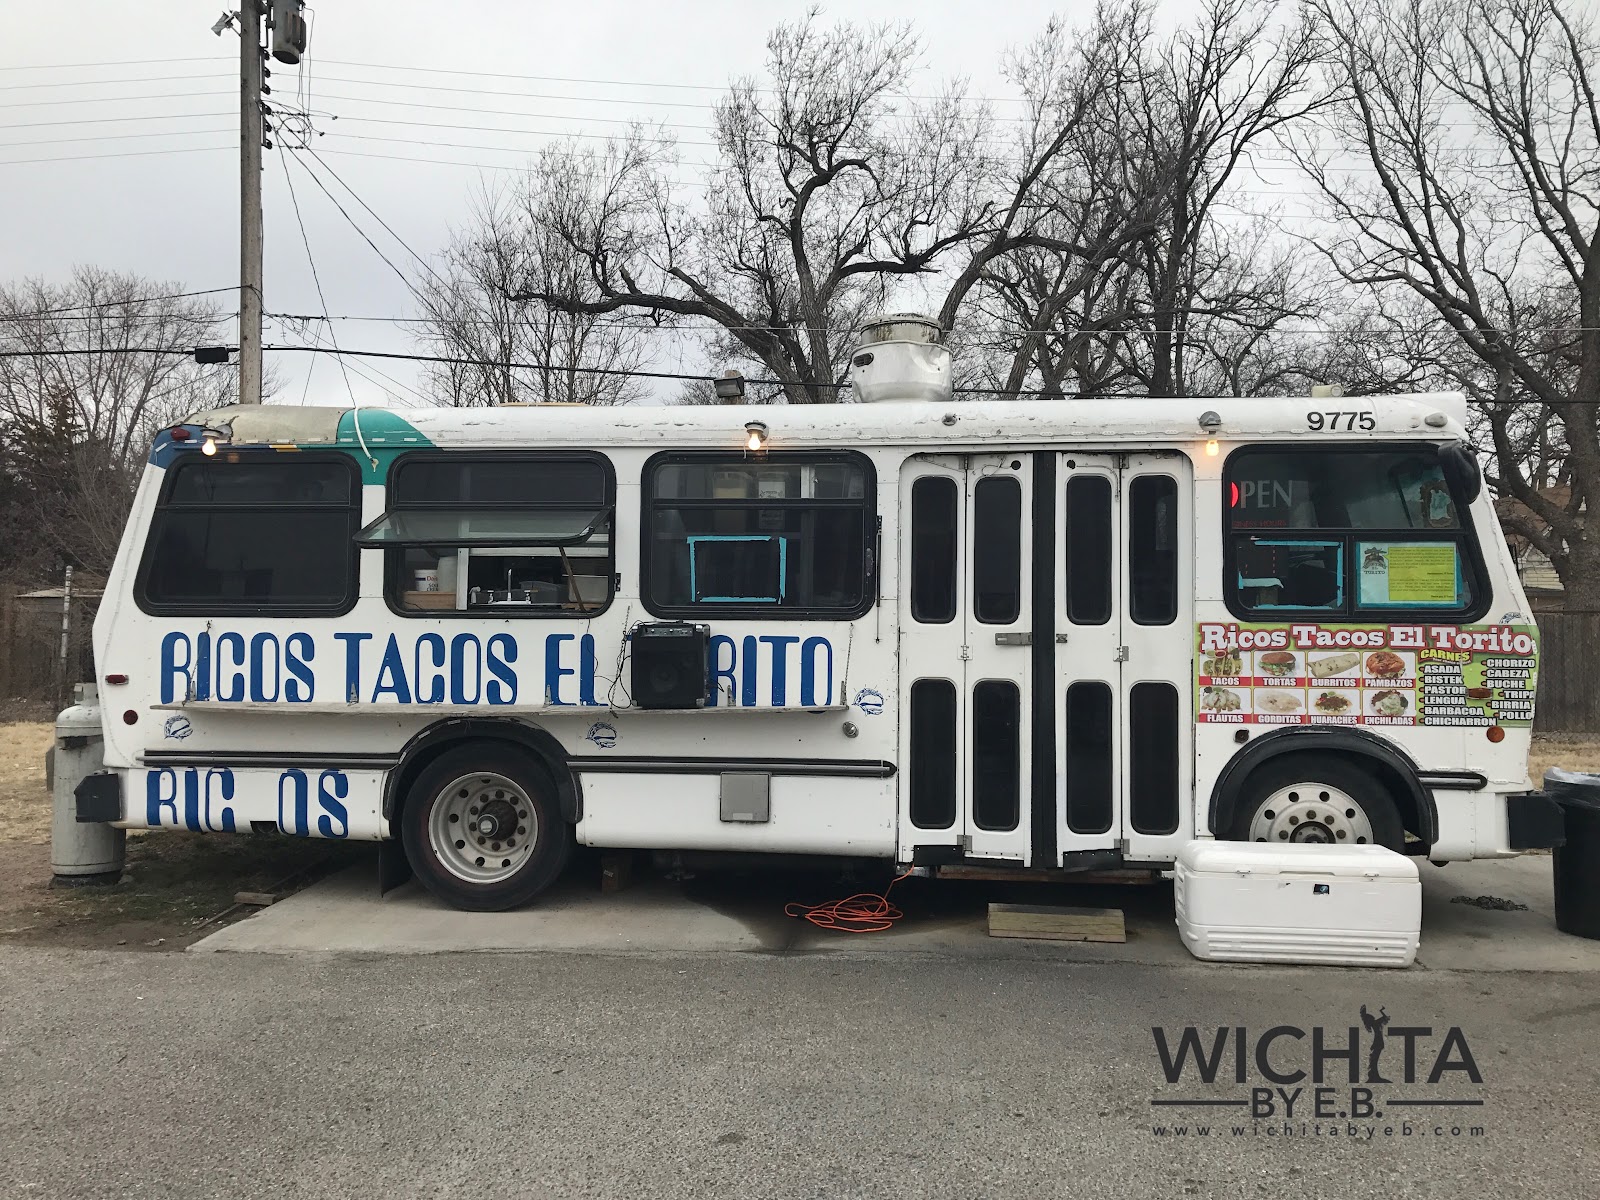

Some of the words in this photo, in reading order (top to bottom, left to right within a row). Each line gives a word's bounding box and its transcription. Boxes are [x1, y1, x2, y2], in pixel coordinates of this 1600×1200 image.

[1306, 411, 1376, 431] 9775
[1231, 480, 1293, 508] PEN
[1200, 625, 1288, 650] Ricos
[1292, 625, 1385, 647] Tacos
[1389, 626, 1426, 647] El
[1431, 626, 1532, 654] Torito
[1420, 648, 1470, 661] CARNES
[1486, 659, 1536, 668] CHORIZO
[160, 631, 315, 704] RICOS
[333, 632, 518, 705] TACOS
[545, 633, 609, 706] EL
[625, 634, 833, 707] RITO
[1424, 665, 1461, 674] ASADA
[1486, 669, 1530, 678] CABEZA
[1211, 677, 1240, 686] TACOS
[1263, 677, 1297, 686] TORTAS
[1311, 678, 1357, 687] BURRITOS
[1365, 679, 1413, 688] PAMBAZOS
[1424, 675, 1464, 684] BISTEK
[1487, 680, 1525, 688] BUCHE
[1424, 686, 1466, 694] PASTOR
[1424, 696, 1466, 705] LENGUA
[1491, 701, 1531, 709] BIRRIA
[1424, 706, 1484, 716] BARBACOA
[1500, 711, 1533, 720] POLLO
[1206, 714, 1244, 723] FLAUTAS
[1258, 715, 1302, 724] GORDITAS
[1310, 716, 1358, 724] HUARACHES
[1364, 716, 1414, 725] ENCHILADAS
[1424, 717, 1497, 726] CHICHARRON
